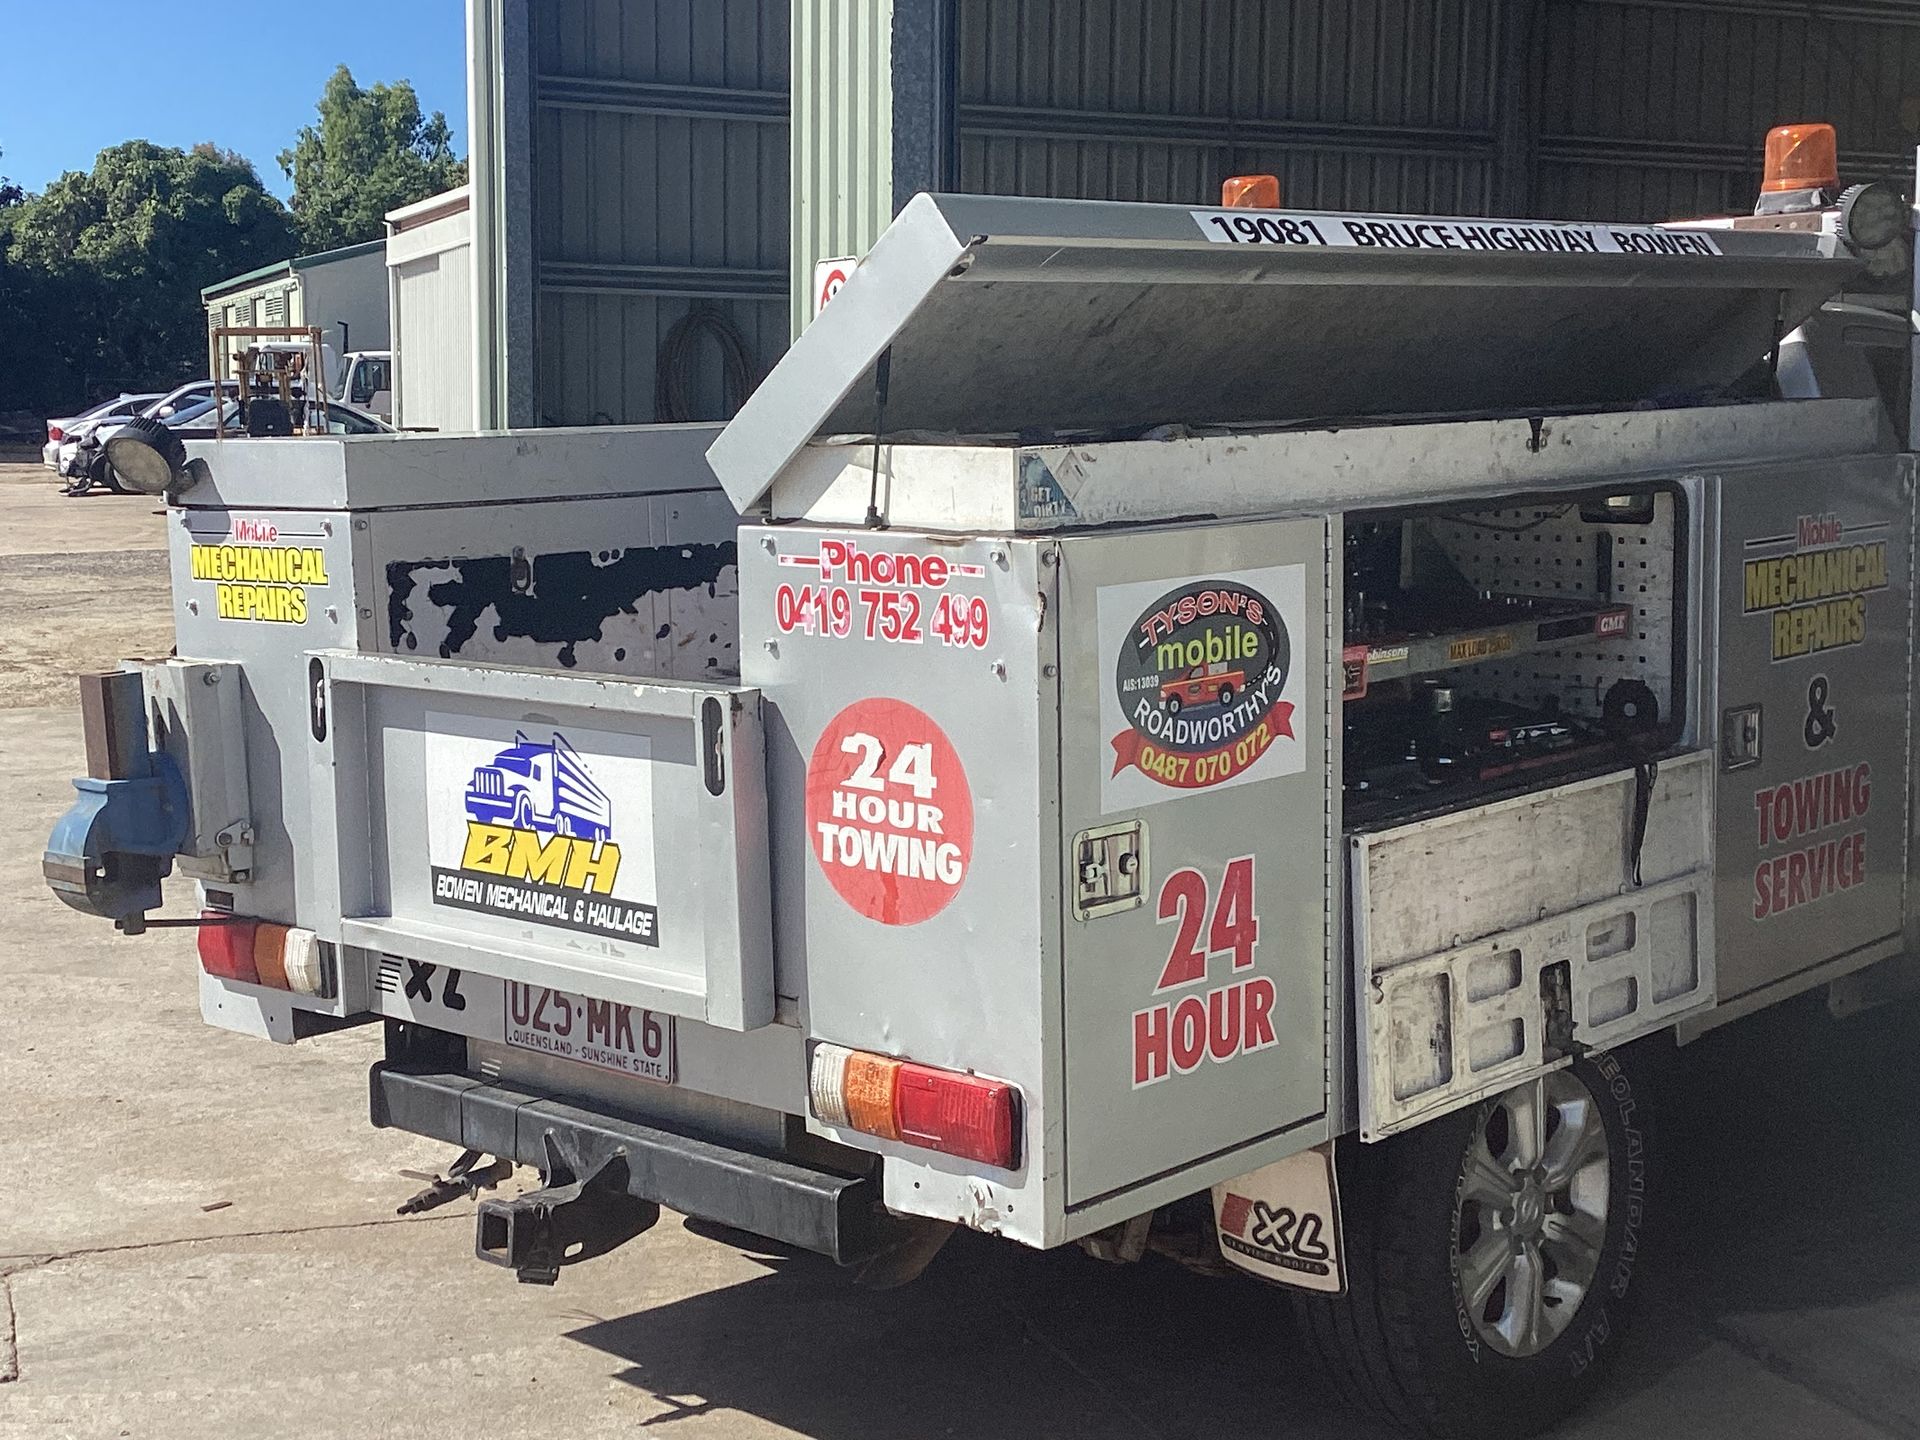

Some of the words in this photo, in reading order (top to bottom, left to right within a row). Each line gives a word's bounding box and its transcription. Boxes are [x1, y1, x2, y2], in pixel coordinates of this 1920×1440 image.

[1211, 216, 1327, 247] 19081
[1343, 221, 1454, 250] BRUCE
[1455, 225, 1598, 253] HIGHWAY
[1609, 231, 1715, 256] BOWEN
[1031, 487, 1051, 503] GET
[190, 544, 329, 586] MECHANICAL
[821, 539, 949, 586] Phone
[1744, 541, 1889, 615] MECHANICAL
[217, 584, 307, 625] REPAIRS
[776, 584, 852, 637] 0419
[860, 590, 924, 643] 752
[931, 594, 990, 649] 499
[1141, 590, 1264, 646] TYSON'S
[1772, 597, 1867, 662] REPAIRS
[1157, 625, 1259, 672] mobile
[1133, 664, 1282, 744] ROADWORTHY'S
[1804, 675, 1838, 750] &
[840, 732, 938, 799] 24
[1140, 746, 1190, 783] 0487
[1195, 751, 1232, 784] 070
[1236, 722, 1271, 767] 072
[832, 789, 945, 835] HOUR
[1755, 762, 1872, 848] TOWING
[460, 819, 621, 896] BMH
[817, 821, 963, 885] TOWING
[1753, 832, 1867, 920] SERVICE
[436, 873, 484, 904] BOWEN
[486, 883, 570, 921] MECHANICAL
[573, 900, 585, 924] &
[587, 903, 654, 937] HAULAGE
[1154, 854, 1260, 994] 24
[513, 1028, 573, 1055] QUEENSLAND
[581, 1046, 628, 1070] SUNSHINE
[633, 1057, 662, 1078] STATE
[1131, 975, 1280, 1091] HOUR
[1252, 1200, 1330, 1261] XL
